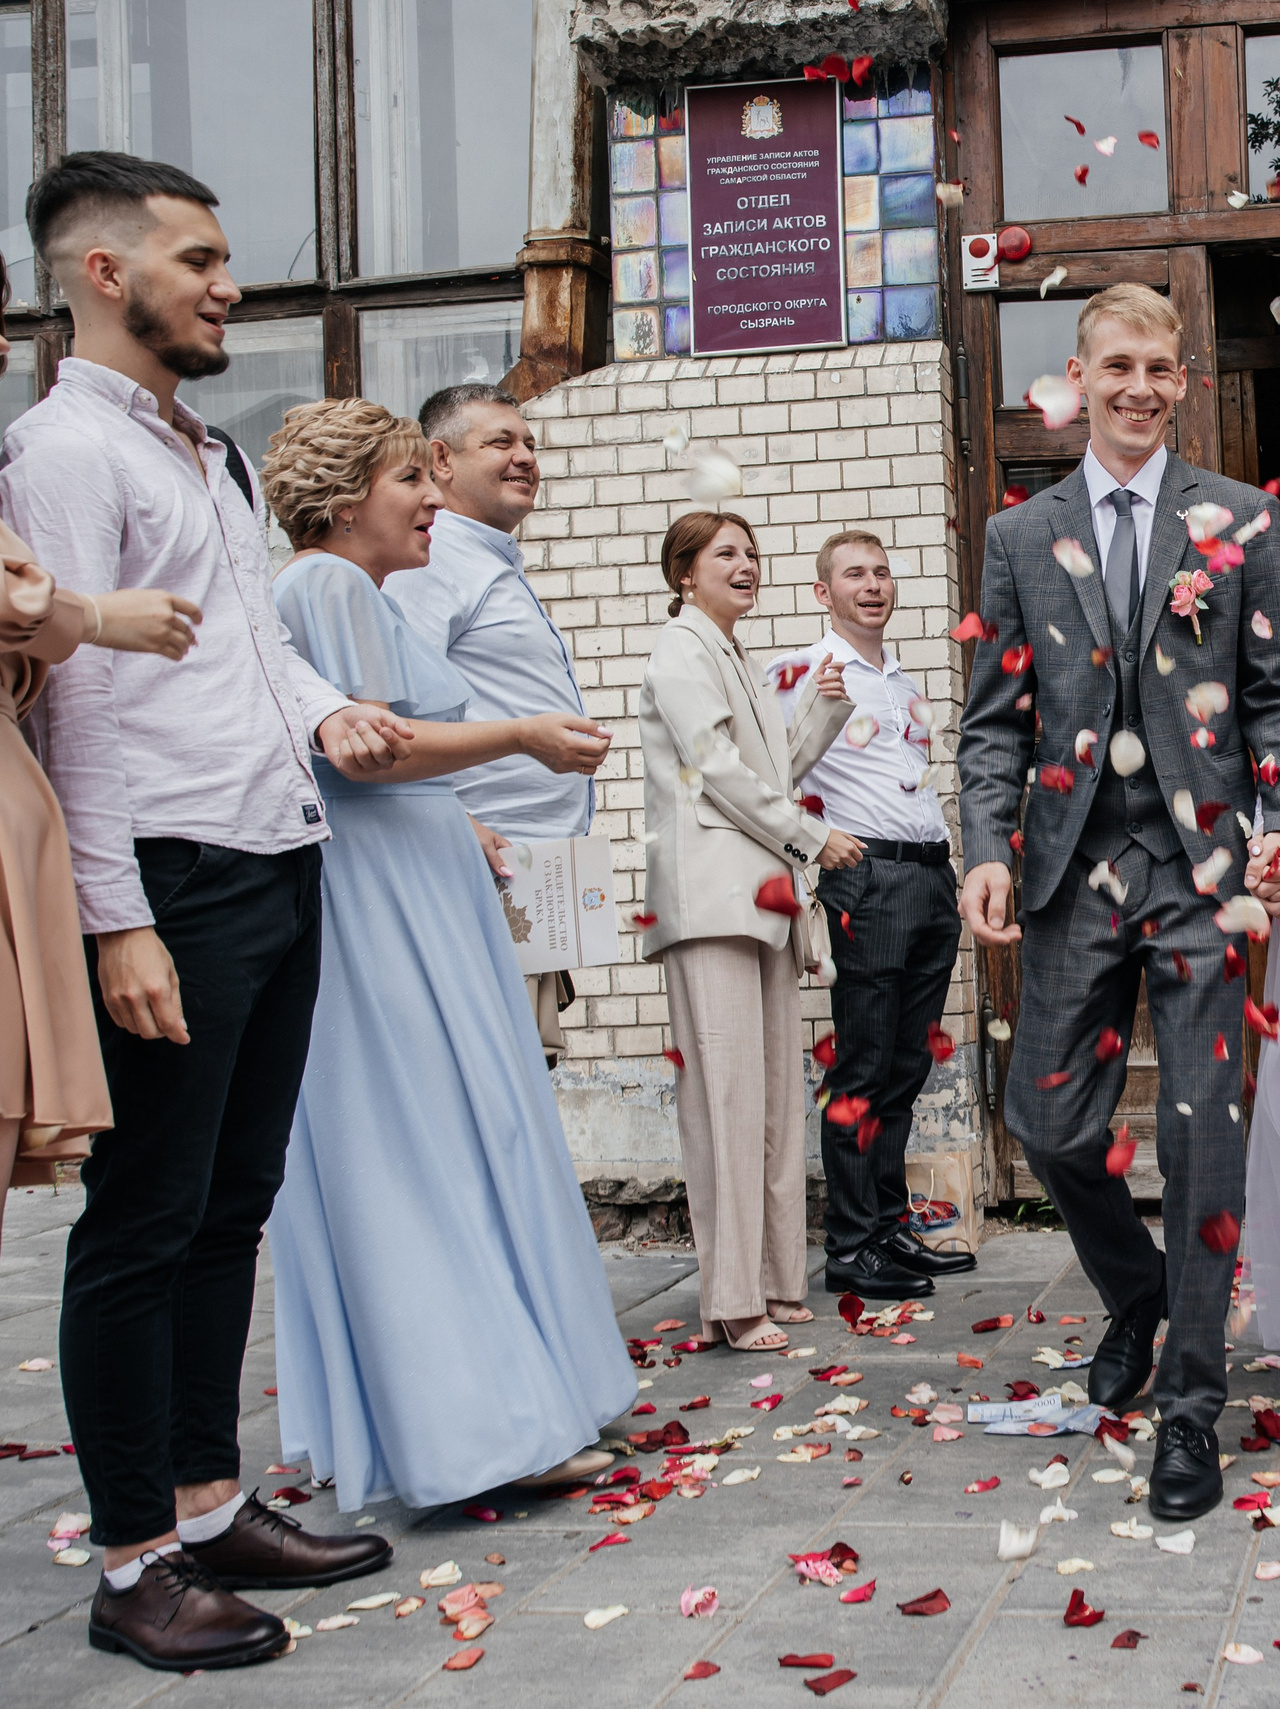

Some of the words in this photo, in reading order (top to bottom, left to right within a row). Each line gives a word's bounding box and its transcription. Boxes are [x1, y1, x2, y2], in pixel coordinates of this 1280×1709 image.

[707, 153, 758, 164] УПРАВЛЕНИЕ
[759, 152, 791, 160] ЗАПИСИ
[793, 150, 819, 158] АКТОВ
[707, 164, 769, 175] ГРАЖДАНСКОГО
[771, 161, 819, 169] СОСТОЯНИЯ
[720, 174, 768, 185] САМАРСКОЙ
[770, 173, 807, 181] ОБЛАСТИ
[737, 194, 790, 210] ОТДЕЛ
[703, 218, 768, 236] ЗАПИСИ
[772, 215, 826, 230] АКТОВ
[701, 238, 830, 259] ГРАЖДАНСКОГО
[716, 262, 815, 280] СОСТОЯНИЯ
[707, 301, 782, 315] ГОРОДСКОГО
[784, 298, 827, 310] ОКРУГА
[740, 317, 795, 329] СЫЗРАНЬ
[544, 860, 552, 868] О
[534, 890, 544, 924] БРАКА
[544, 871, 557, 950] ЗАКЛЮЧЕНИИ
[554, 856, 568, 951] СВИДЕТЕЛЬСТВО
